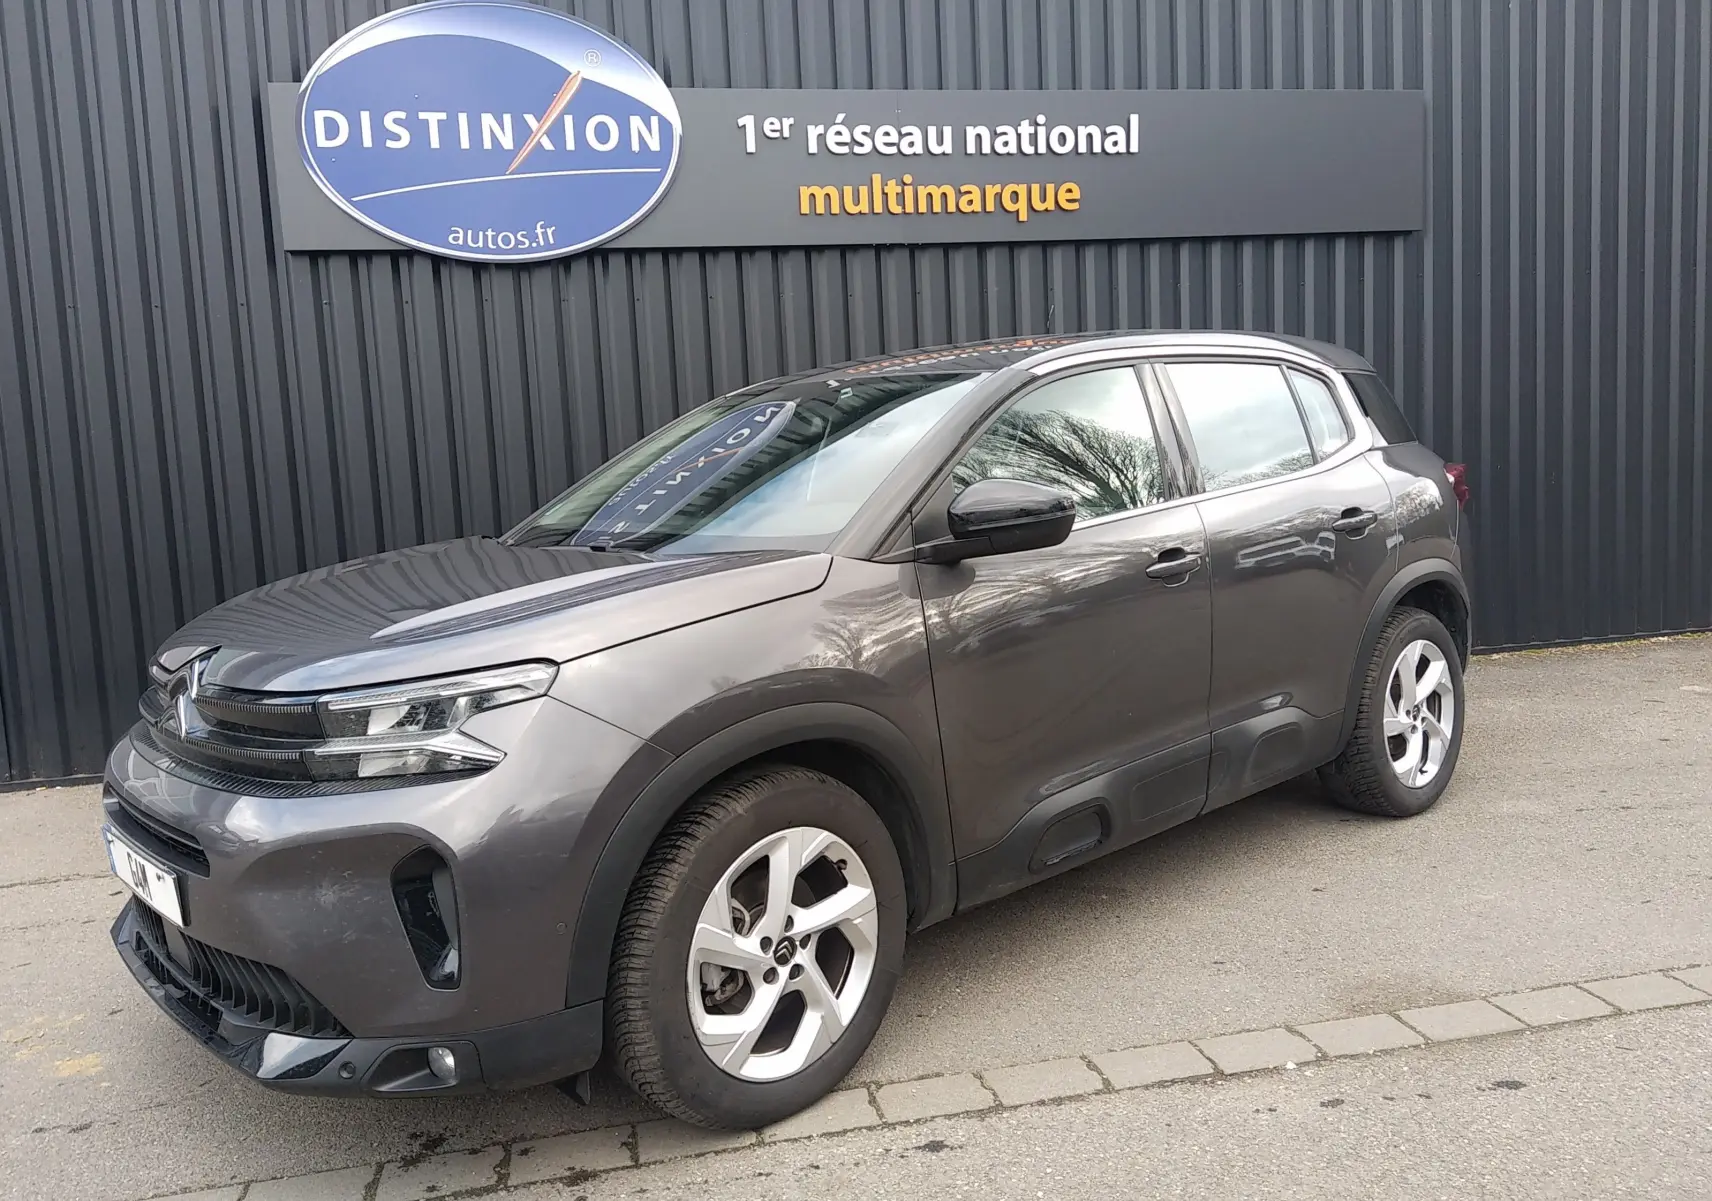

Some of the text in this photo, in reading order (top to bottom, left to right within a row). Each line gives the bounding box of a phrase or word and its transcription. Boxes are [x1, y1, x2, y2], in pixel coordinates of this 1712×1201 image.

[313, 109, 661, 152] DISTINXION
[737, 112, 1139, 155] 1er réseau national
[799, 173, 1081, 221] multimarque
[448, 221, 557, 249] autos.fr
